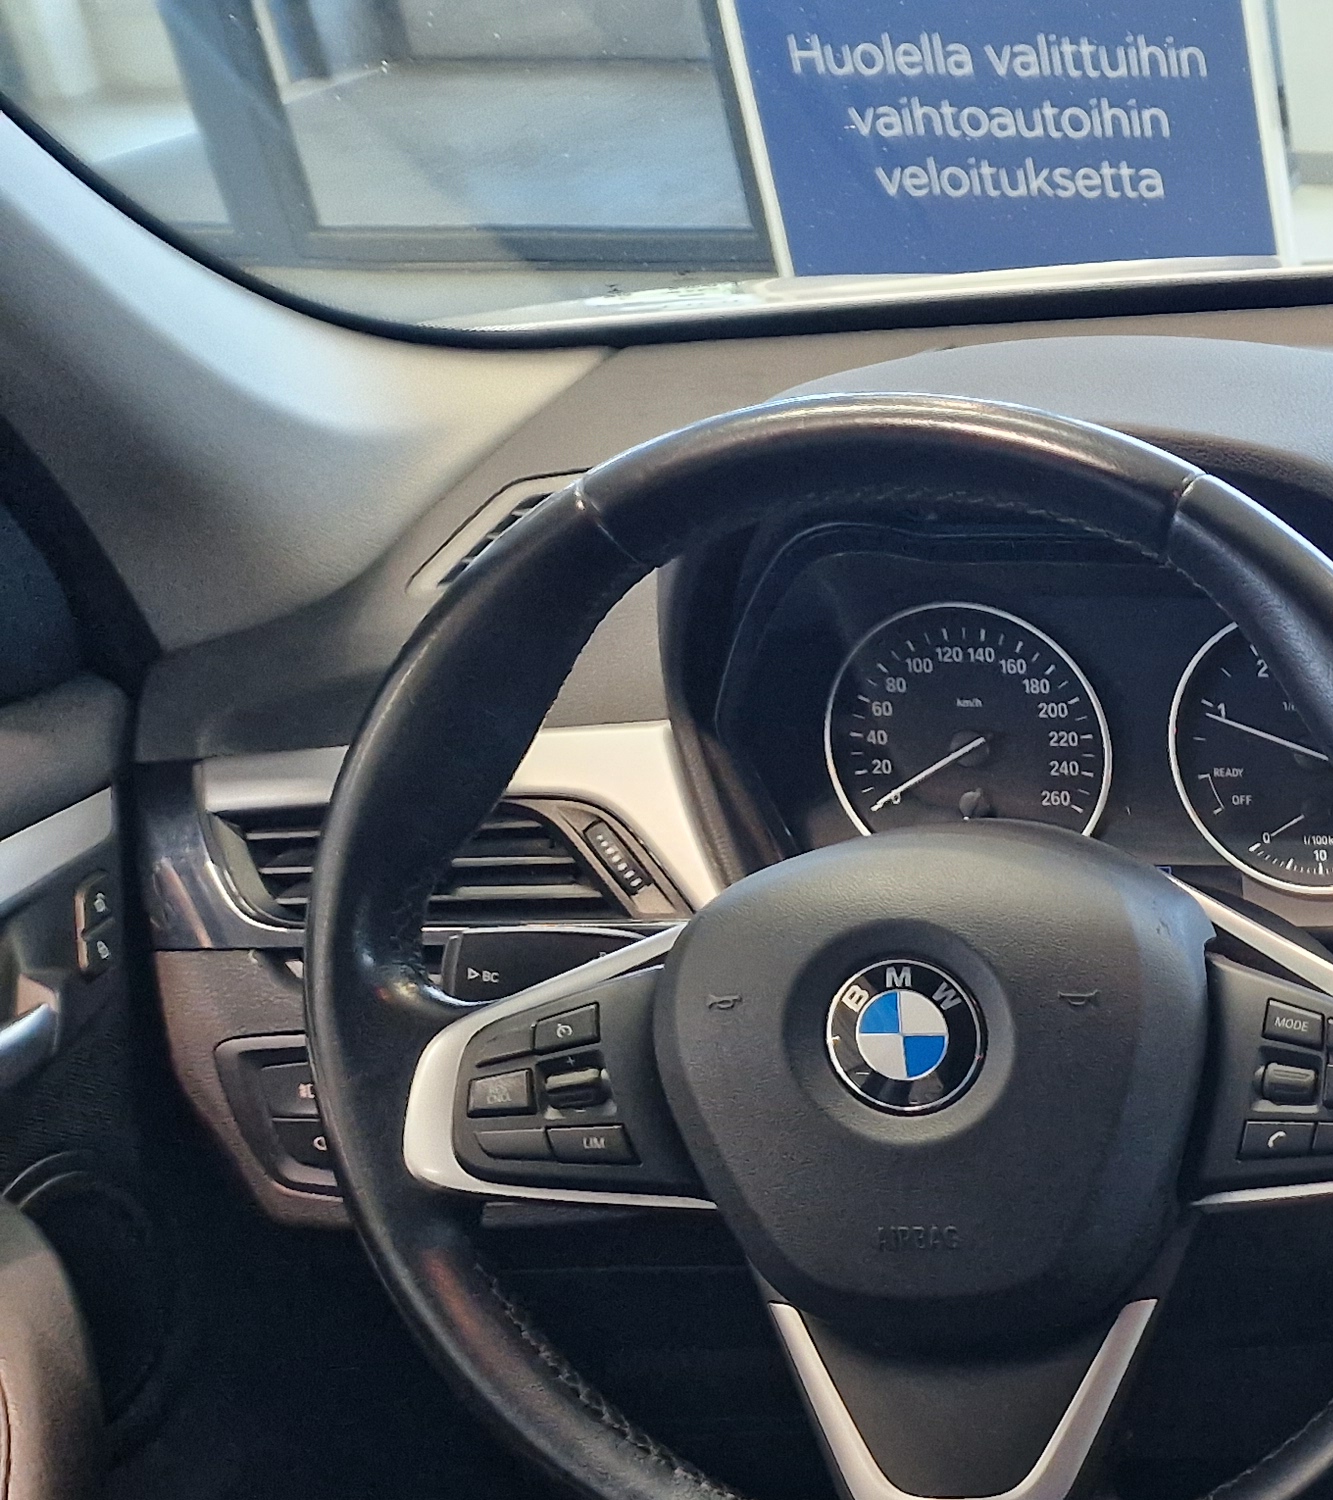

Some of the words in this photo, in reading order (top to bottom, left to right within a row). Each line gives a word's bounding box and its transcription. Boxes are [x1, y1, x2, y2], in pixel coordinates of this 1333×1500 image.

[787, 32, 973, 77] Huolella
[984, 33, 1208, 78] valittuihin
[847, 97, 1170, 140] vaihtoautoihin
[874, 157, 1165, 200] veloituksetta
[935, 646, 963, 662] 120
[967, 647, 995, 662] 140
[905, 657, 933, 673] 100
[1000, 658, 1027, 675] 160
[1256, 659, 1269, 677] 2
[885, 677, 907, 694] 80
[1022, 678, 1050, 694] 180
[872, 702, 893, 717] 60
[956, 697, 983, 708] km/h
[1038, 702, 1068, 718] 200
[1217, 702, 1226, 719] 1
[867, 730, 888, 745] 40
[1049, 732, 1079, 747] 220
[872, 759, 892, 775] 20
[1050, 761, 1080, 776] 240
[1213, 768, 1245, 778] READY
[1041, 790, 1071, 807] 260
[1232, 795, 1252, 806] OFF
[1262, 832, 1270, 844] 0
[1313, 849, 1327, 861] 10
[482, 970, 500, 983] BC
[841, 966, 961, 1012] BMW
[1274, 1016, 1309, 1032] MODE
[583, 1137, 606, 1149] LIM
